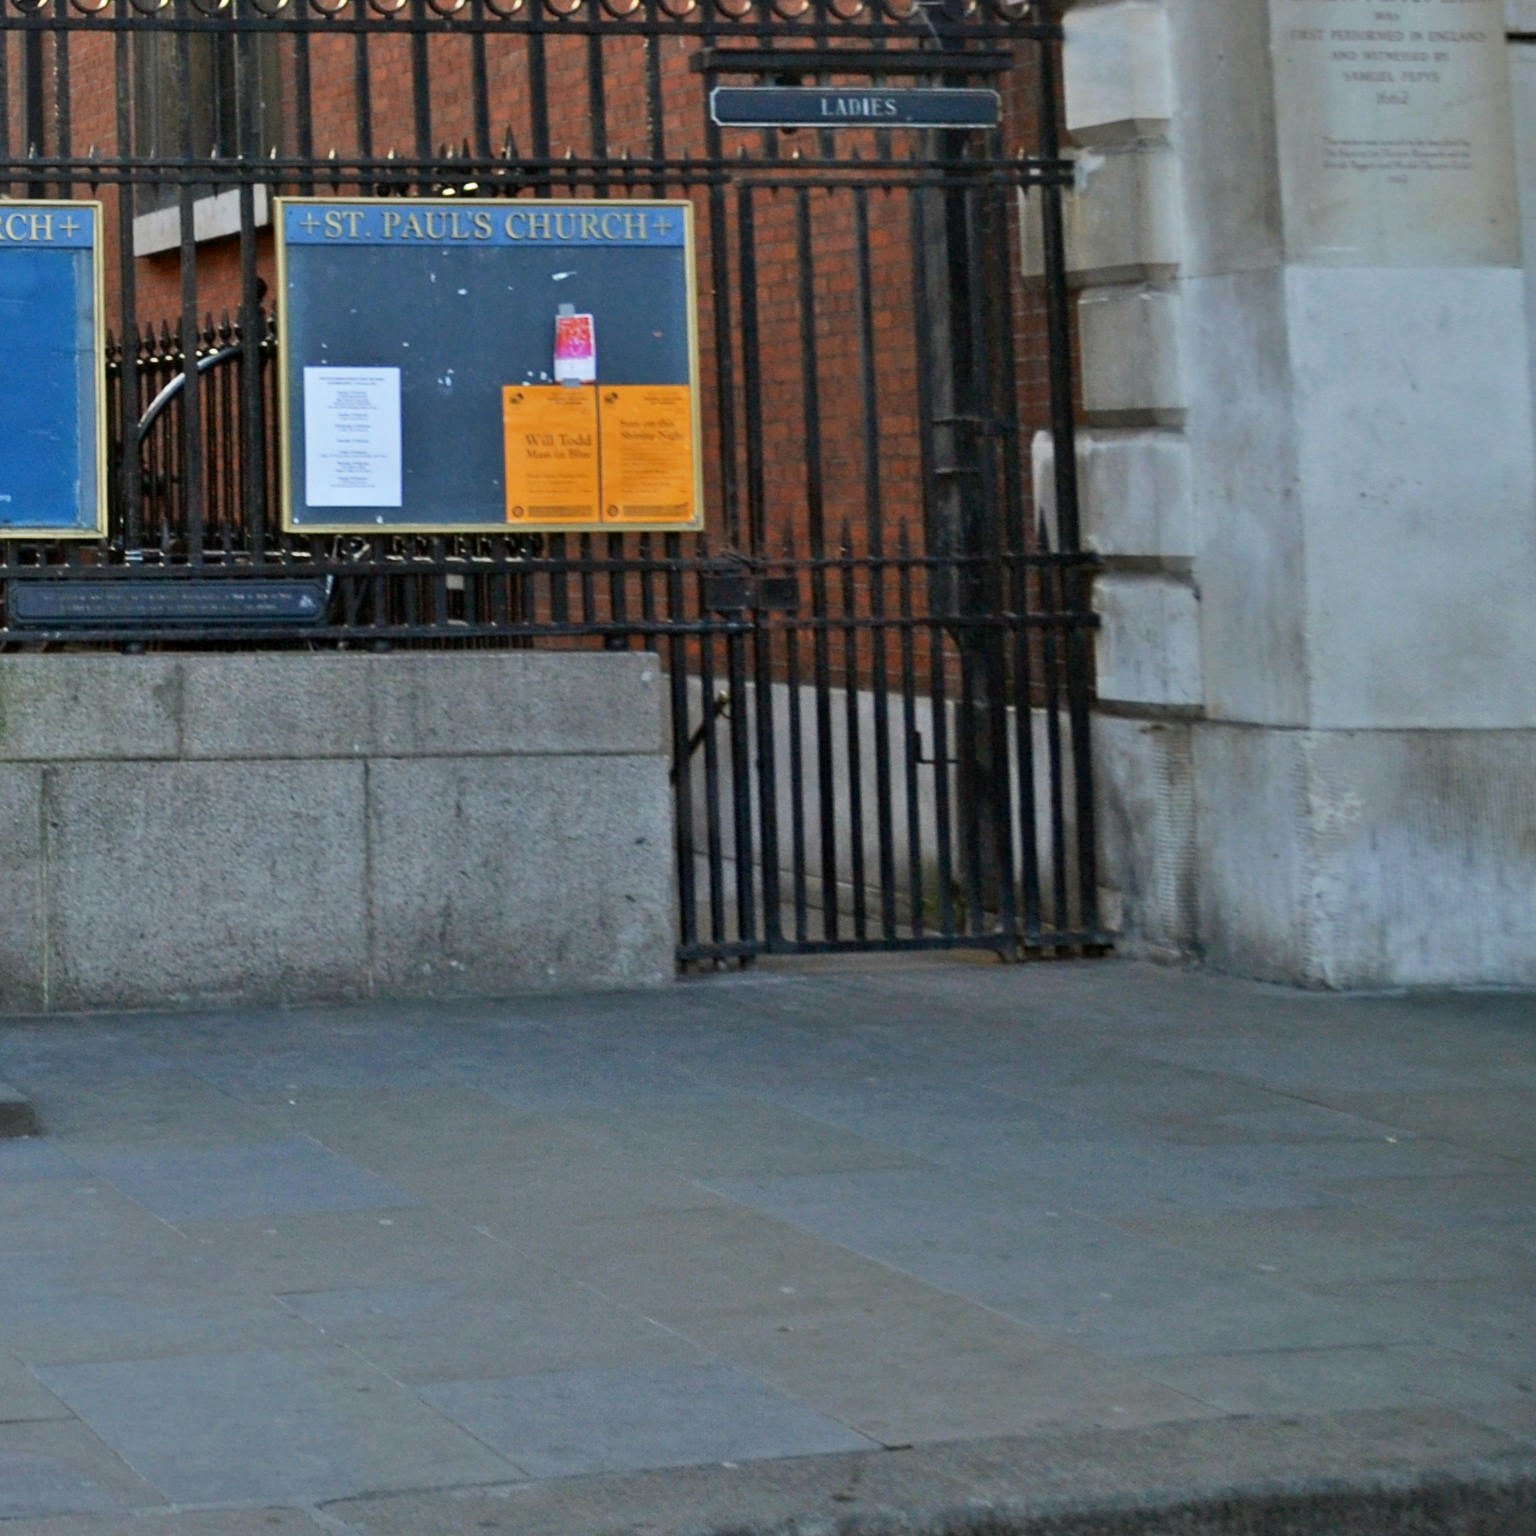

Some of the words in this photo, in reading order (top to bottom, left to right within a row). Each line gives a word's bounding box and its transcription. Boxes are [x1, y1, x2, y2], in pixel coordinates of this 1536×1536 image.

[820, 97, 897, 116] LADIES
[324, 210, 371, 239] ST.
[382, 211, 493, 240] PAUL'S
[504, 212, 649, 241] CHURCH
